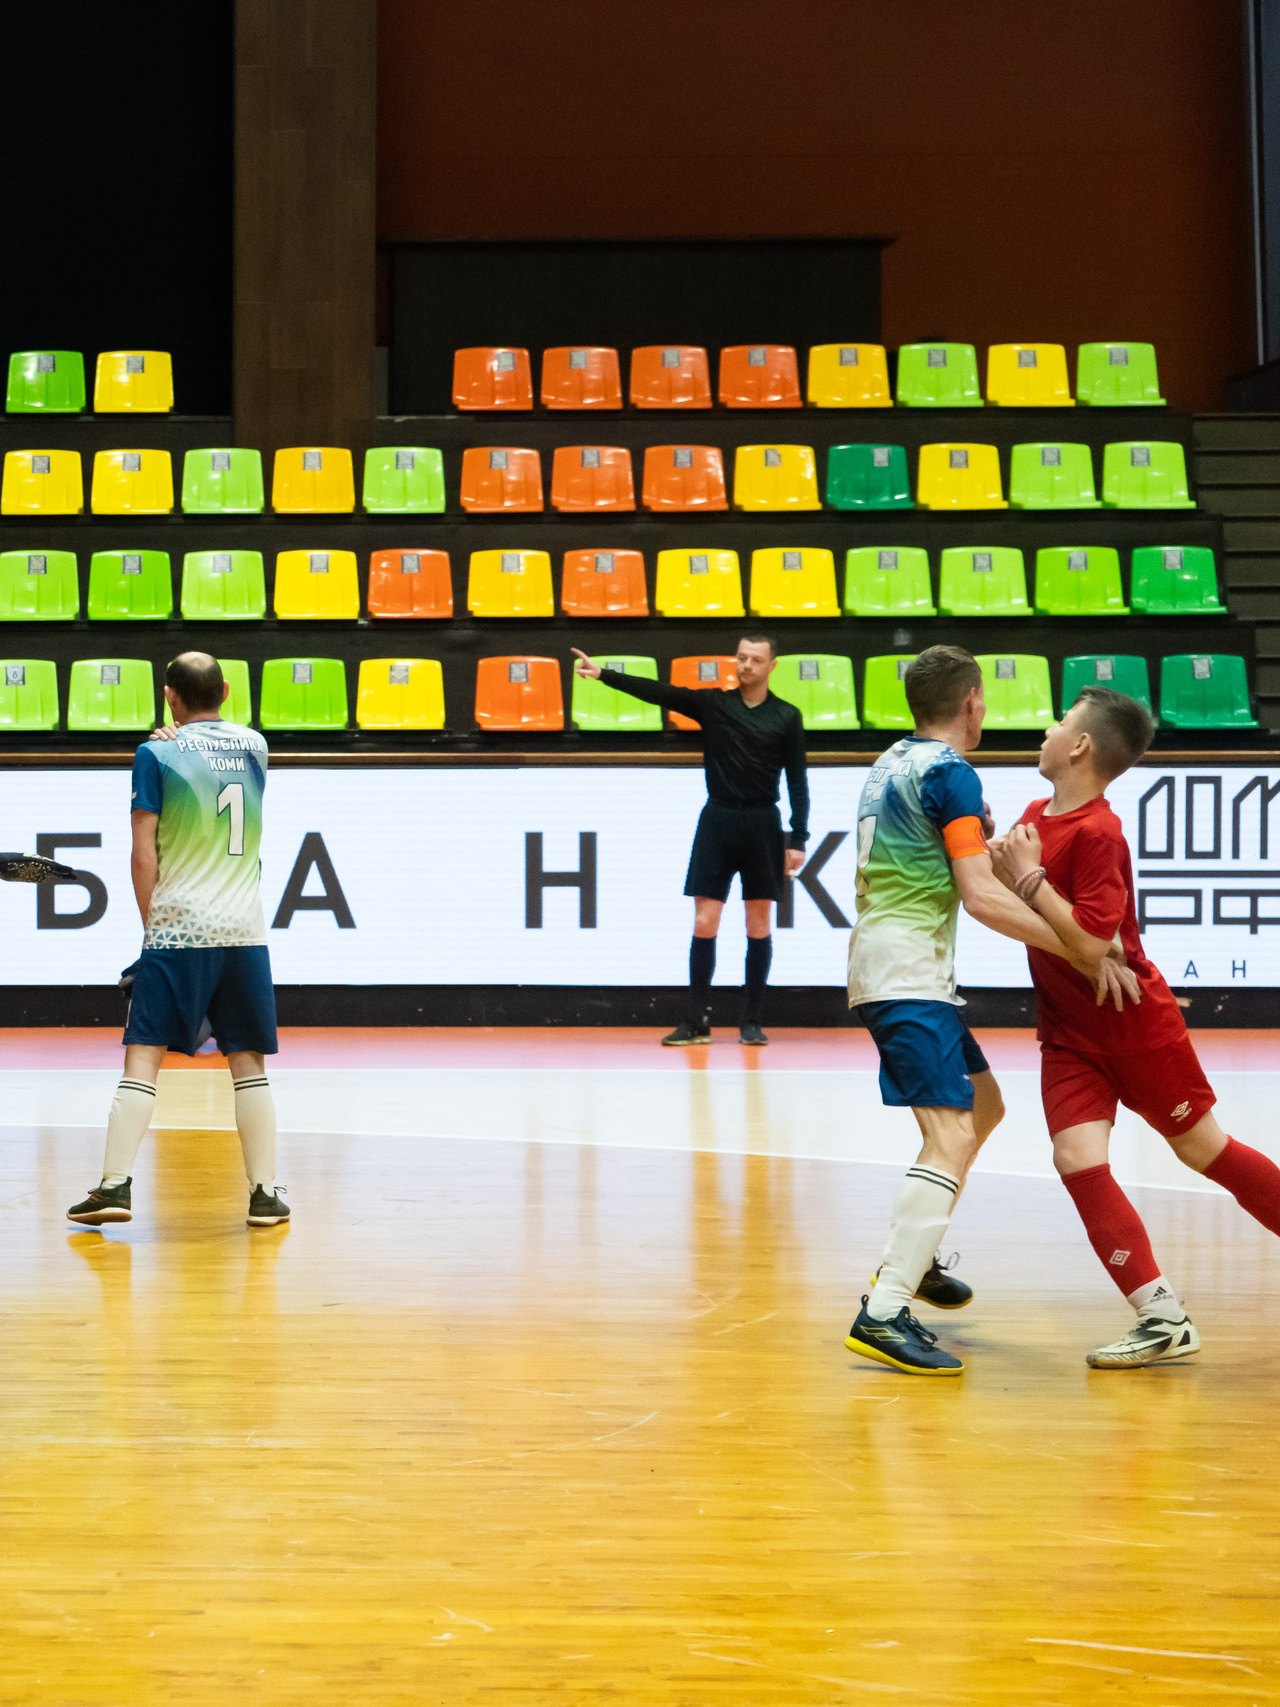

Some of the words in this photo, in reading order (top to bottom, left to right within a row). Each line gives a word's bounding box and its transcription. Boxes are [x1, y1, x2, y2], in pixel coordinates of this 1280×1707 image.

[177, 737, 264, 754] РЕСПУБЛИКА
[208, 756, 246, 772] КОМИ
[216, 782, 245, 856] 1
